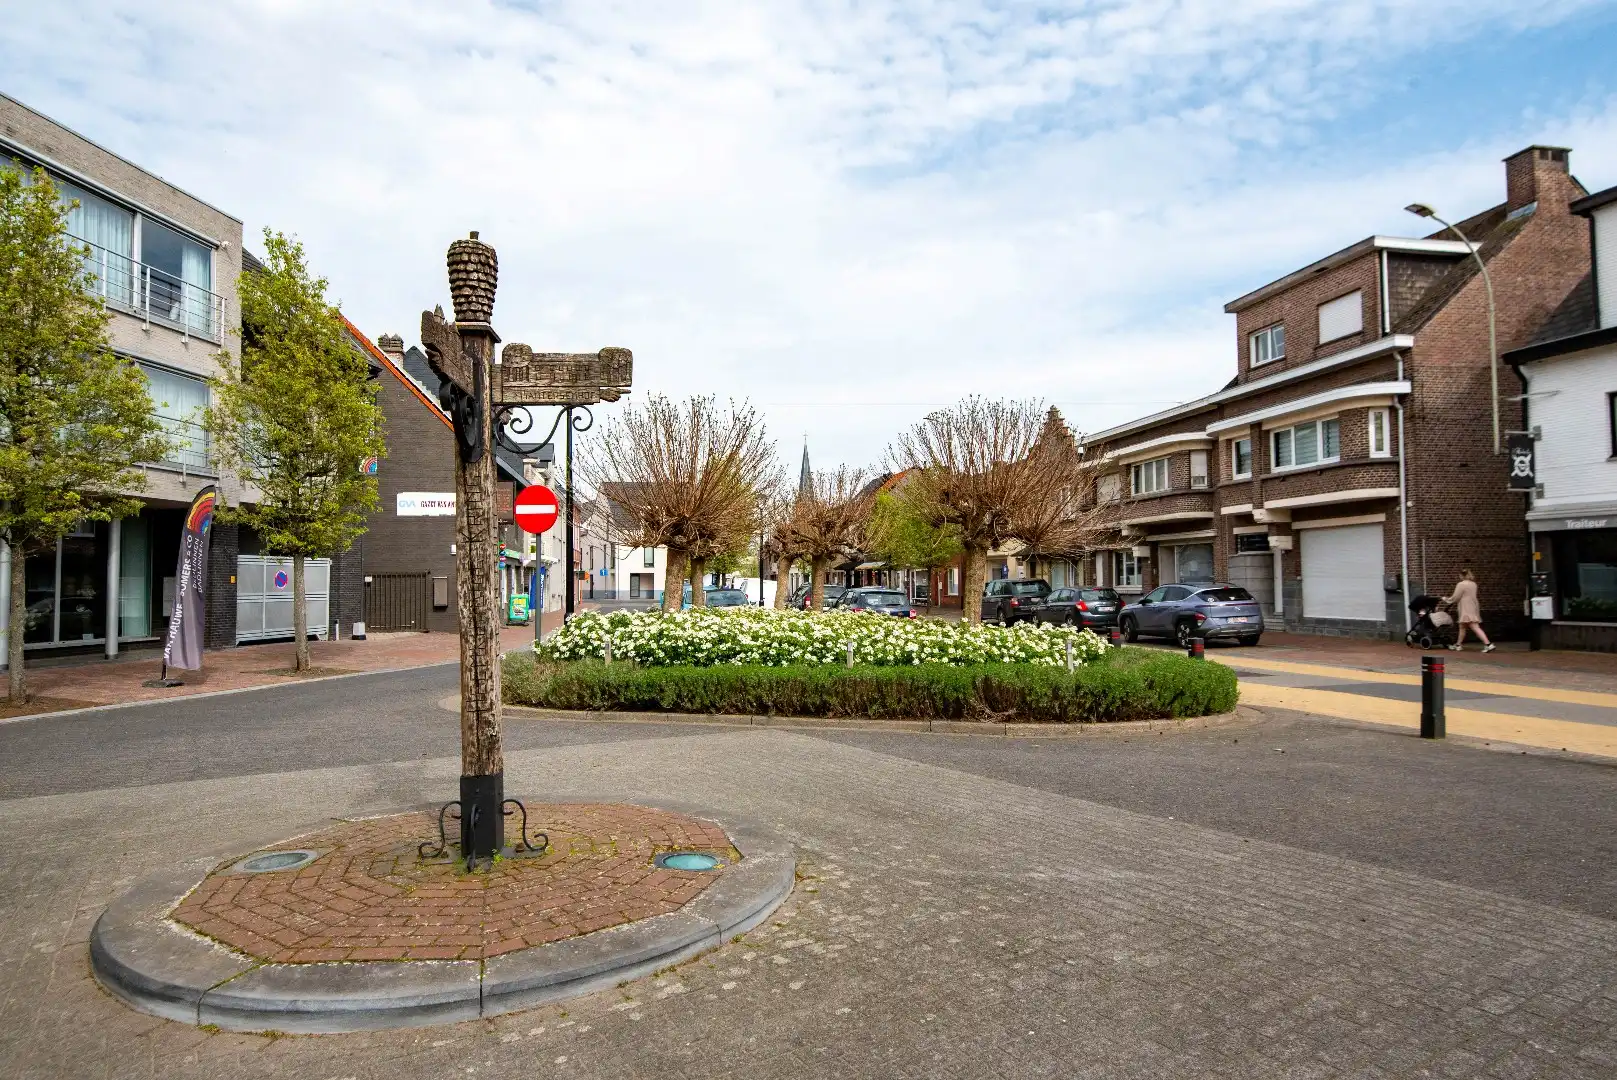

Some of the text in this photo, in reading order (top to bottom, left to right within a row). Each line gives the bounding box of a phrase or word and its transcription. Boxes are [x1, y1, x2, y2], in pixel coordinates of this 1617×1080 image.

[460, 475, 488, 544] KRING
[1564, 519, 1608, 529] Traiteur
[186, 534, 193, 549] CO
